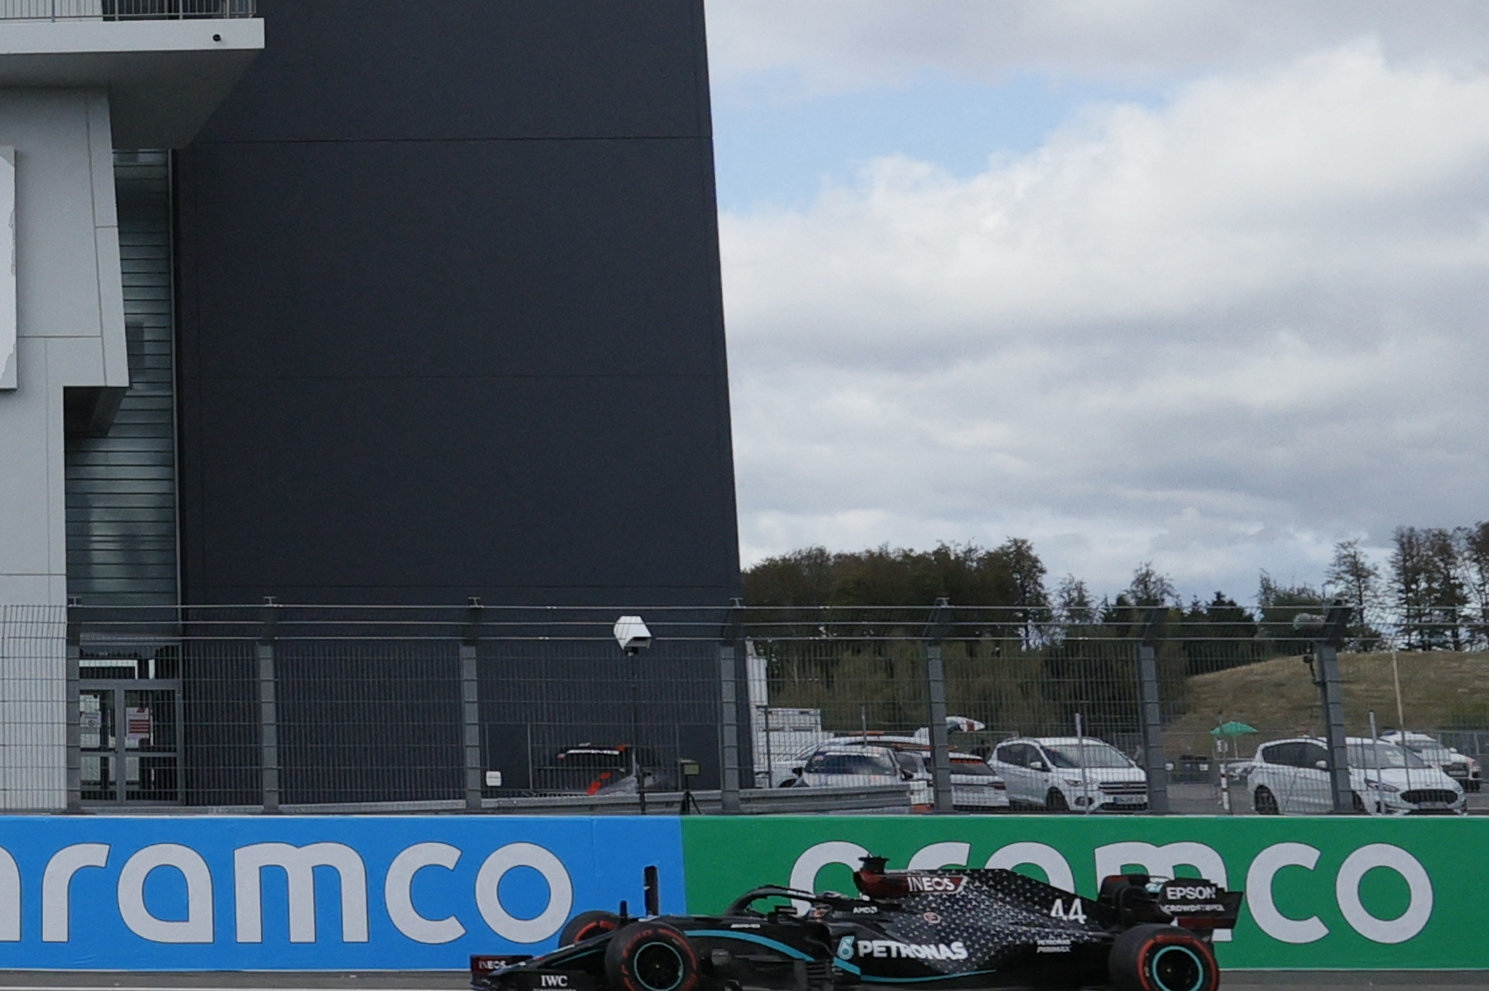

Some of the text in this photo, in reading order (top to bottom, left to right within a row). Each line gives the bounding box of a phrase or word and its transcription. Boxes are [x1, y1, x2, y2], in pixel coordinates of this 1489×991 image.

[908, 876, 954, 892] INEOS
[1165, 886, 1216, 901] EPSON
[1050, 897, 1088, 925] 44
[857, 939, 969, 961] PETRONAS
[478, 960, 507, 970] INEOS
[540, 975, 569, 987] IWC
